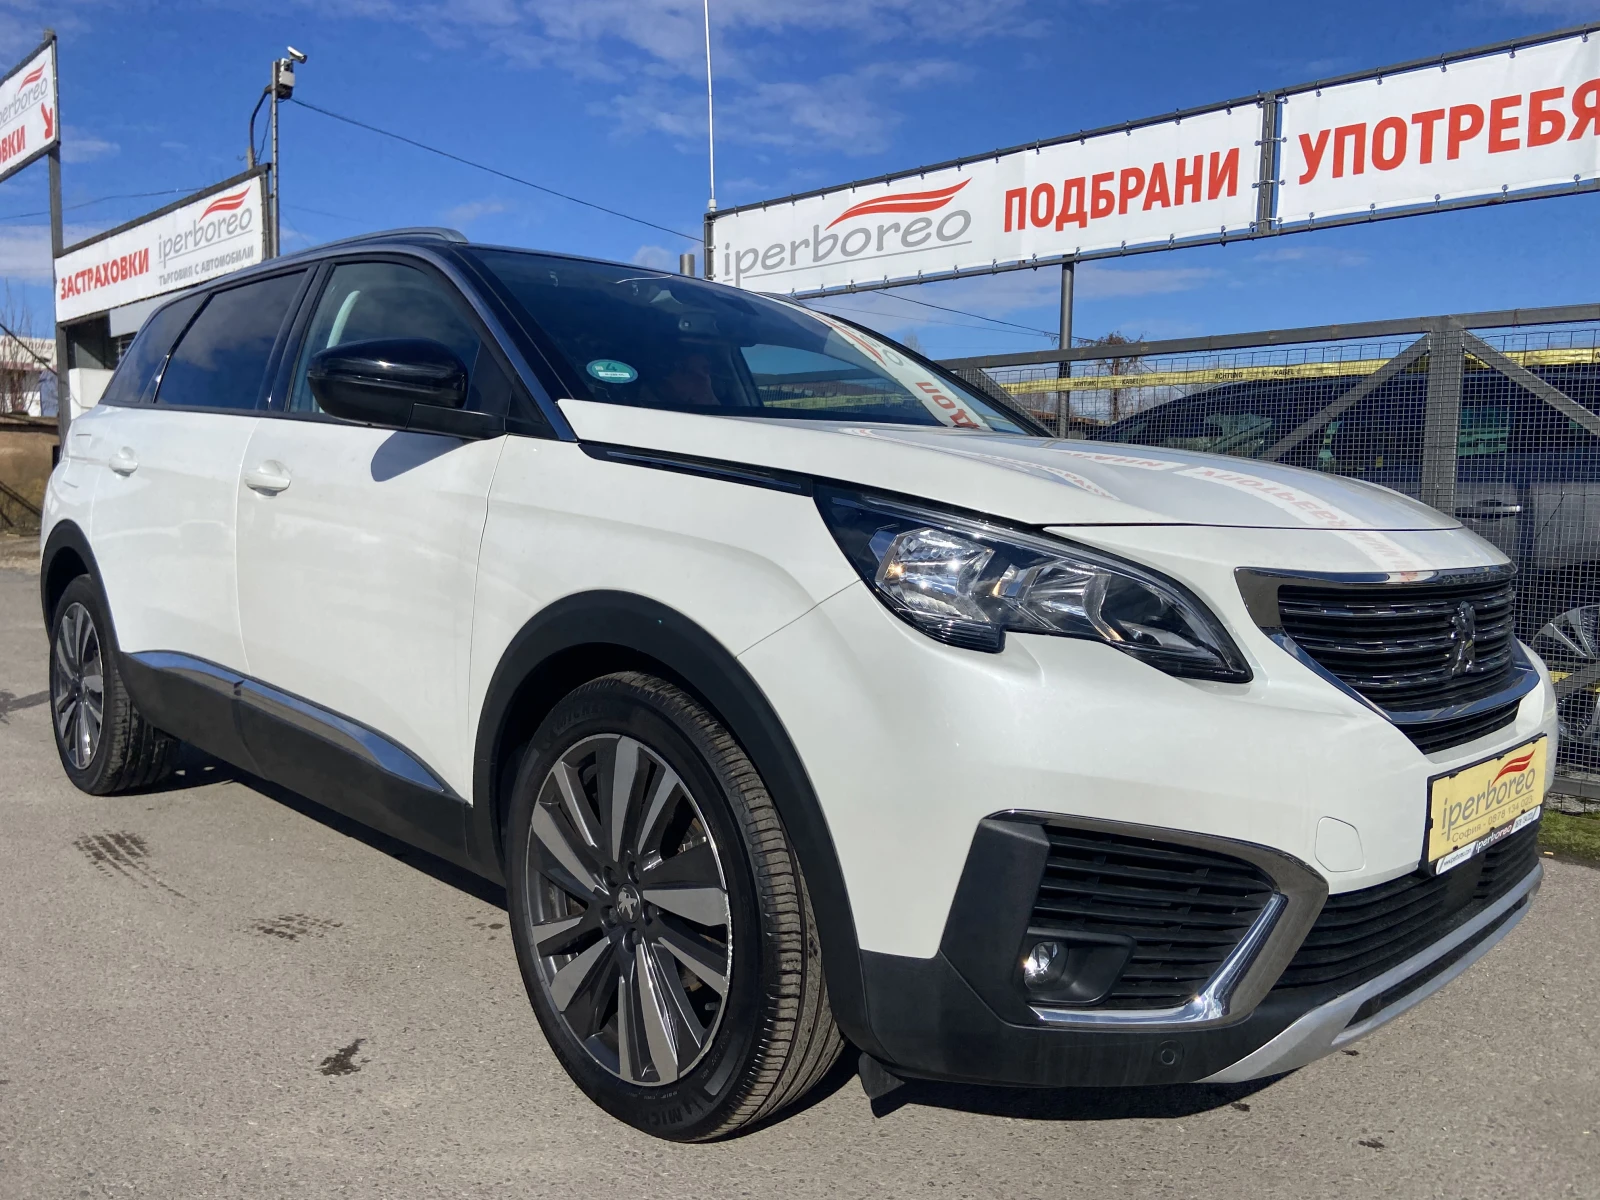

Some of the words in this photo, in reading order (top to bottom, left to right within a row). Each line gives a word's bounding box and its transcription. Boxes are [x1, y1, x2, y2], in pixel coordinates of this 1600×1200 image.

[1298, 77, 1600, 185] УПОТРЕБЯ
[1003, 147, 1240, 232] ПОДБРАНИ
[158, 207, 252, 269] iperboreo
[200, 245, 254, 273] АВТОМОБИЛИ
[723, 209, 972, 288] iperboreo
[60, 248, 150, 300] ЗАСТРАХОВКИ
[1214, 371, 1243, 380] ACHTUNG
[1441, 767, 1536, 842] iperboreo
[1451, 822, 1483, 843] София
[1487, 809, 1506, 826] 0878
